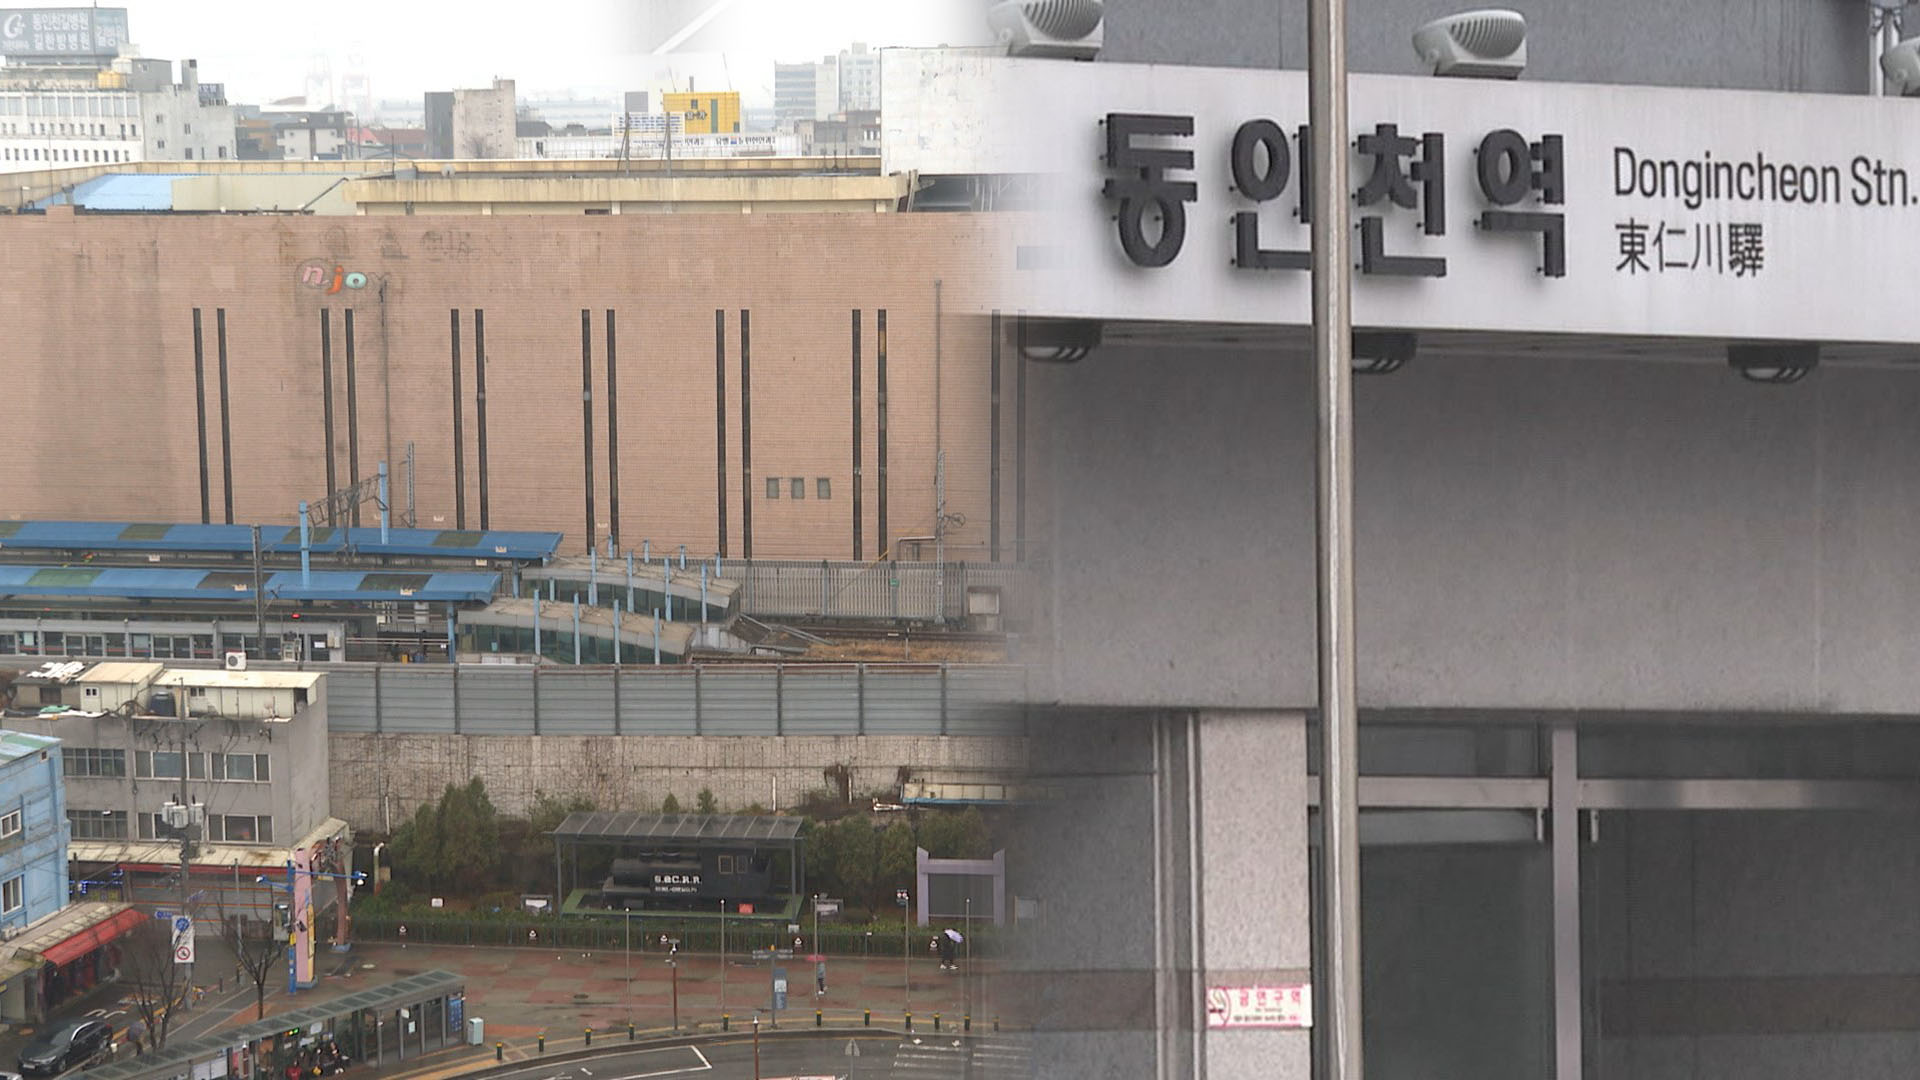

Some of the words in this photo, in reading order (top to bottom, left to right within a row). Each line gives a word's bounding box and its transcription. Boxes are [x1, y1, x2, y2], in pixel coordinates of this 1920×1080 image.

[1099, 113, 1566, 278] 동인천역
[1613, 146, 1841, 210] Dongincheon
[1850, 155, 1918, 207] Stn.
[1614, 217, 1765, 278] 東仁川驛
[1239, 988, 1302, 1007] 금연구역
